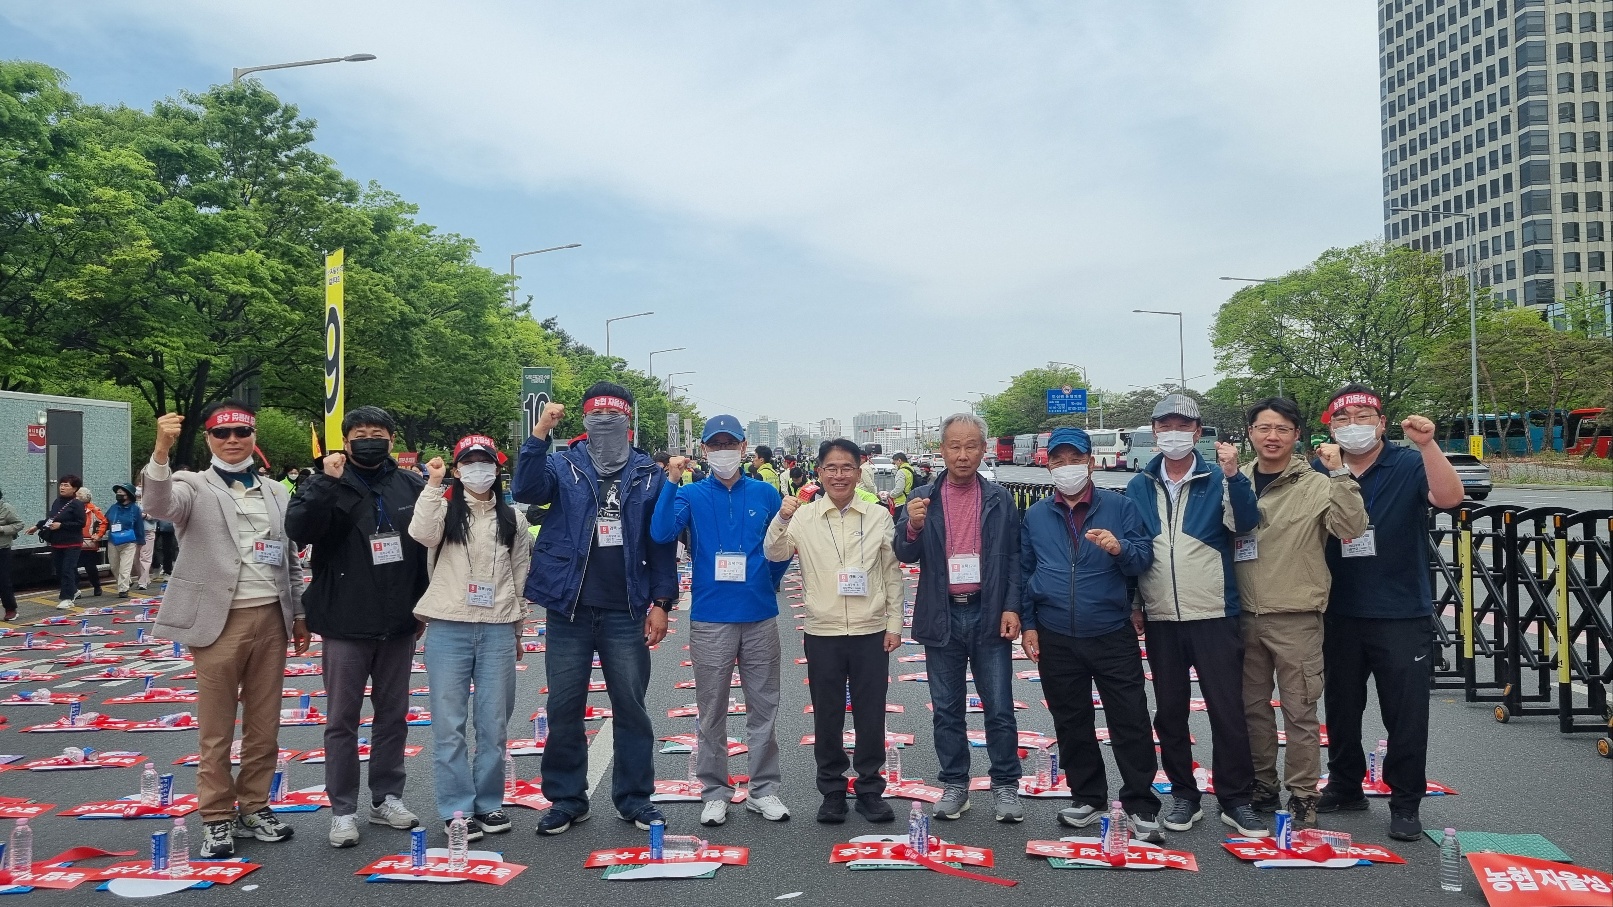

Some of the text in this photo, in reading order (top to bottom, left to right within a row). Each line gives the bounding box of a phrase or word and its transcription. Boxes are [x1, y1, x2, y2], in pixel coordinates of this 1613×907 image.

[325, 304, 341, 416] 9
[594, 397, 607, 407] 농협
[607, 397, 625, 409] 자율성
[1333, 397, 1345, 410] 농협
[1345, 394, 1367, 405] 자율성
[1484, 866, 1612, 893] 농협 자율성
